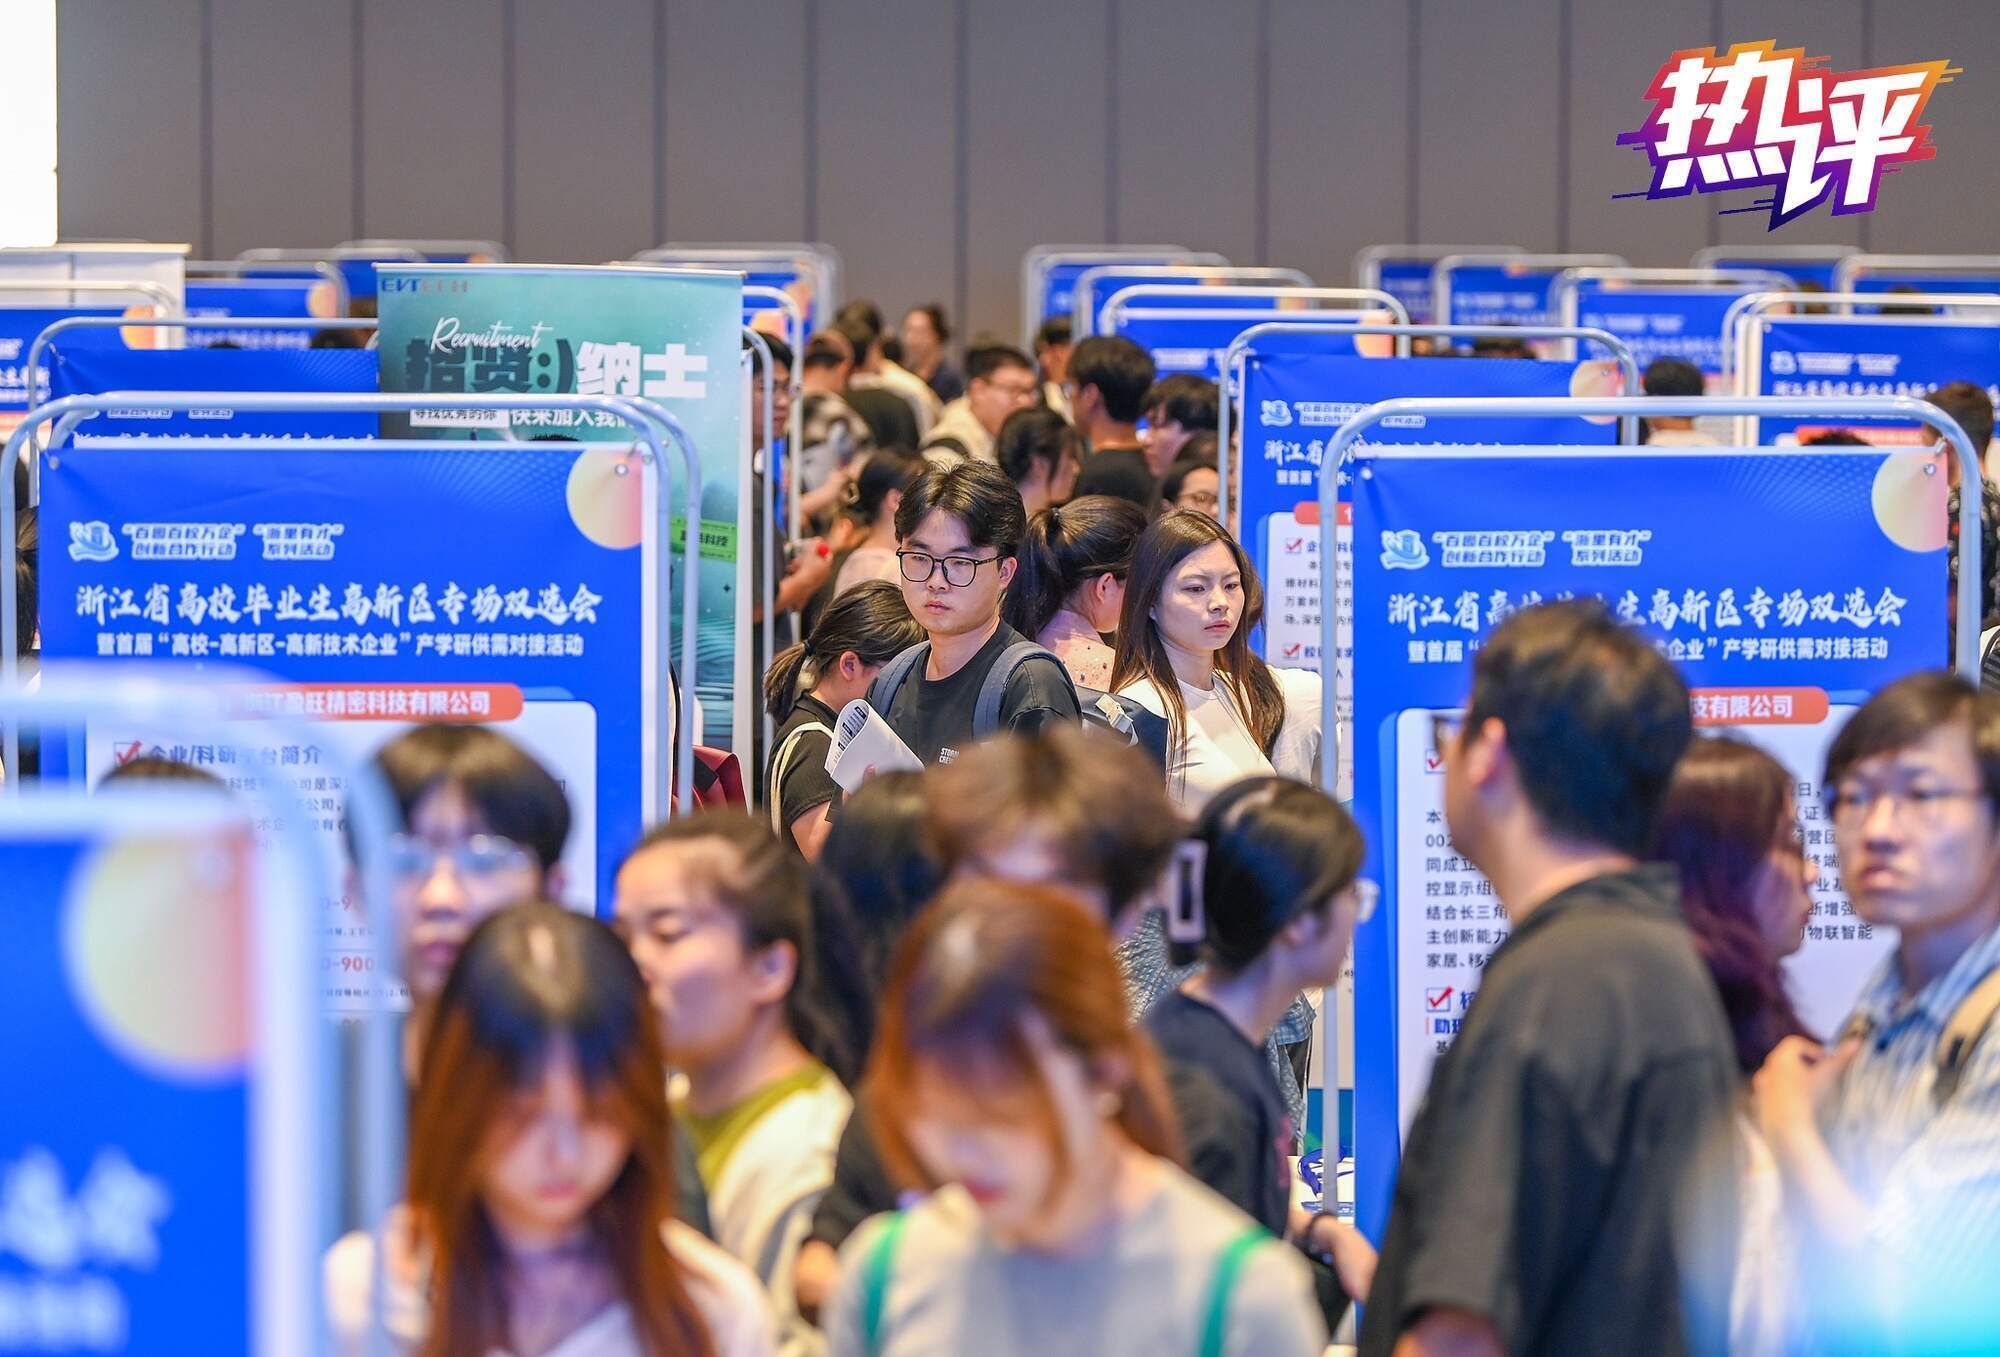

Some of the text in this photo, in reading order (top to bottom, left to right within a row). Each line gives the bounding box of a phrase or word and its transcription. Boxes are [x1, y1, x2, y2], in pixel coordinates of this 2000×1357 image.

[430, 317, 552, 353] Recruitment
[76, 582, 602, 627] 浙江省高校毕业生高新区专场双选会
[1387, 586, 1907, 633] 浙江省高生高新区专场双选会
[1426, 904, 1508, 920] 结合长三角
[1426, 929, 1509, 945] 主创新能力
